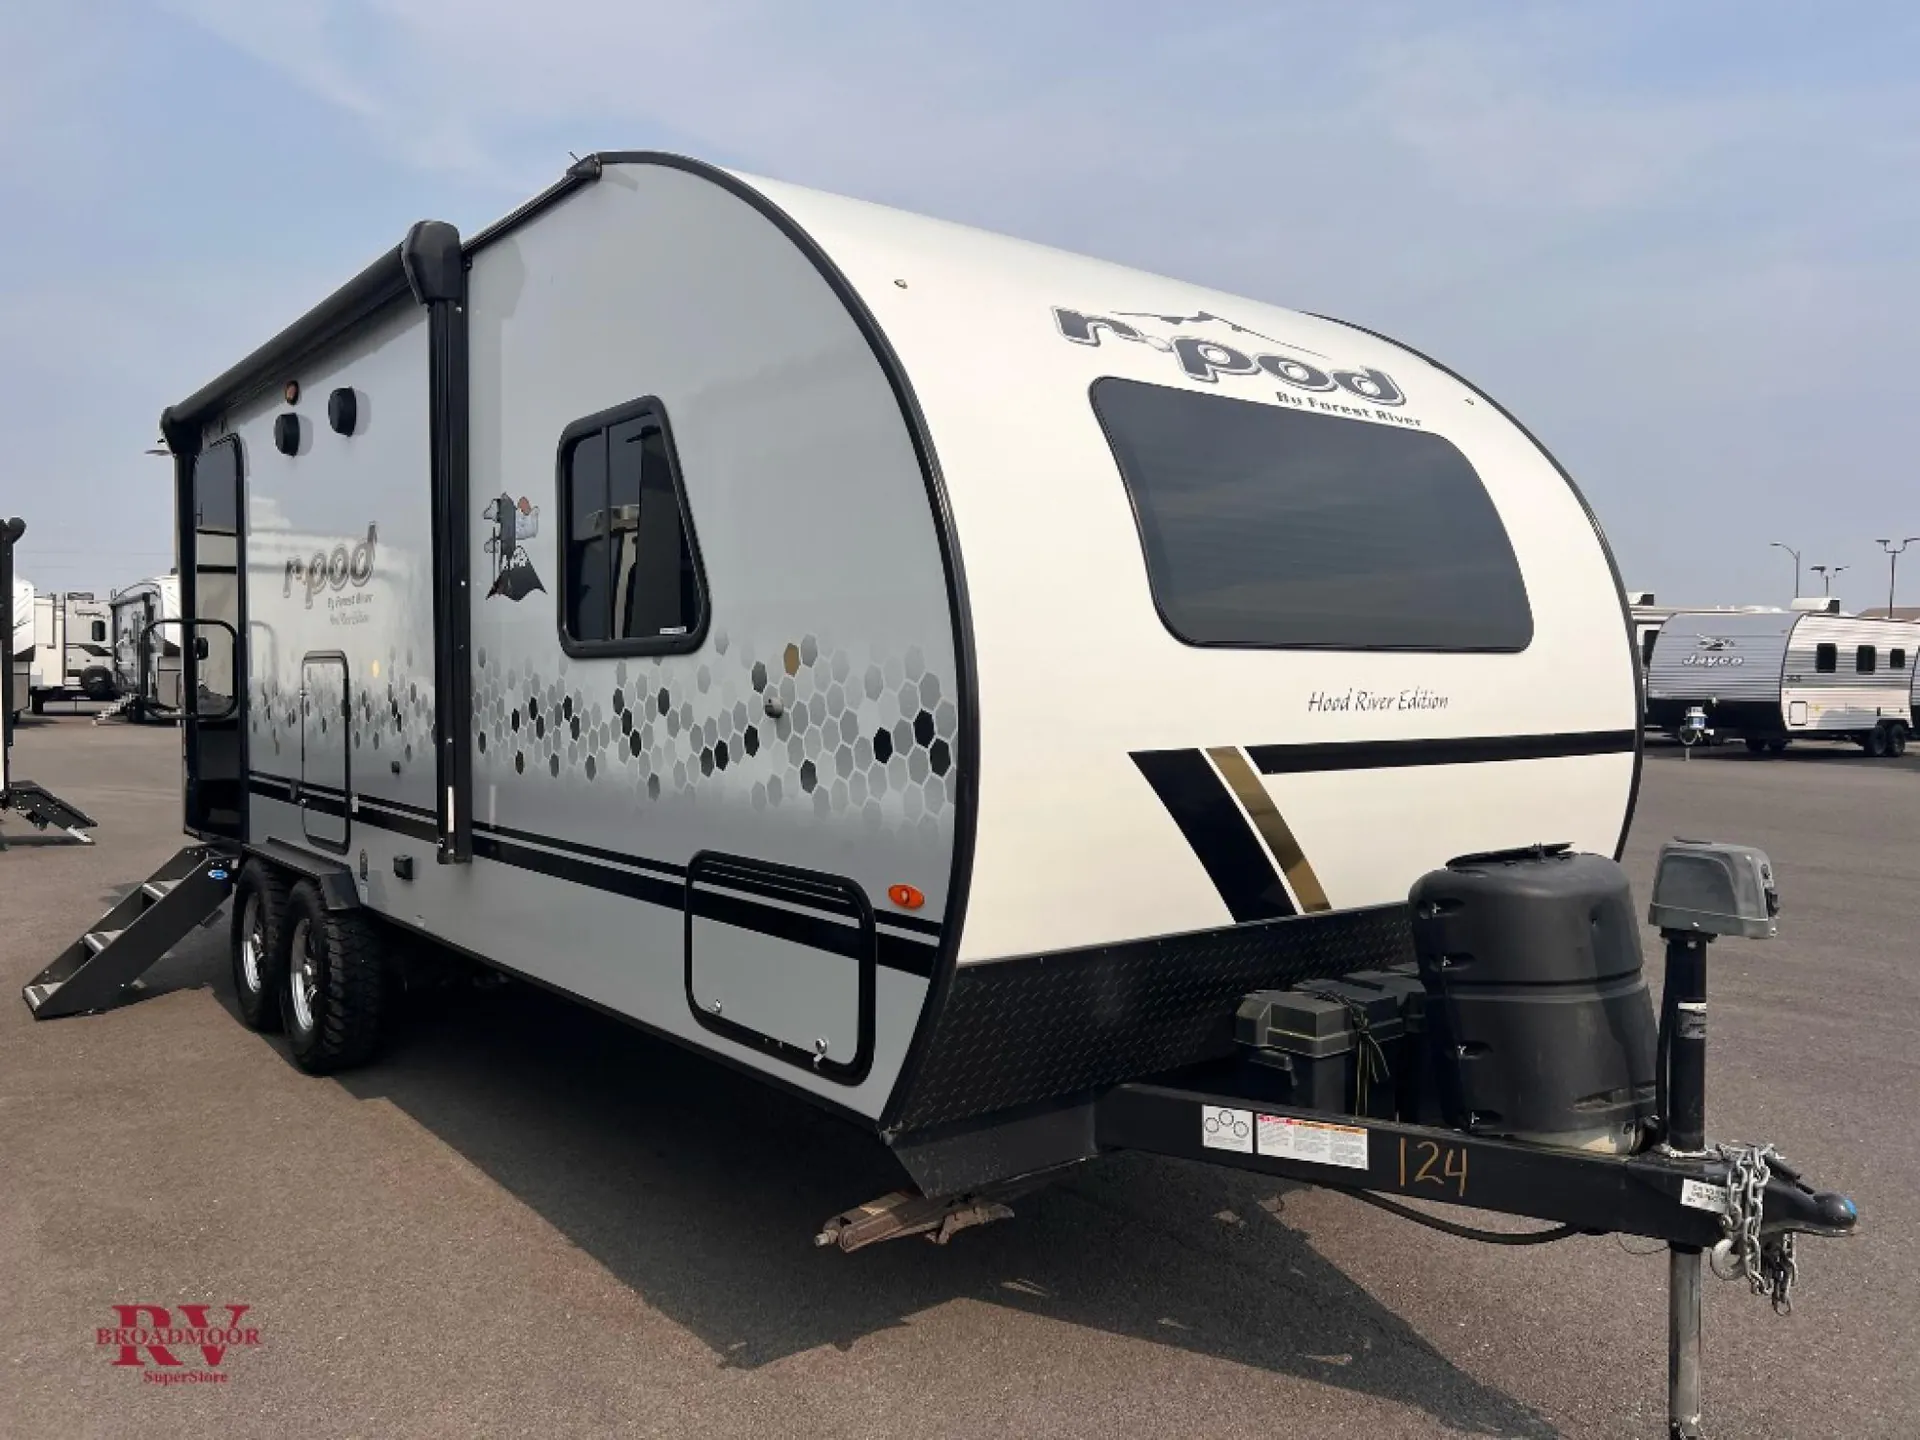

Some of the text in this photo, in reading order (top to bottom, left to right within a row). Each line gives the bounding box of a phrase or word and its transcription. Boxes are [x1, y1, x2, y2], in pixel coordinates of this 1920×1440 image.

[1307, 397, 1373, 419] Forest
[1376, 409, 1422, 427] River
[1682, 653, 1744, 668] Jayco
[1308, 685, 1449, 711] Hood River Edition
[1399, 1136, 1468, 1197] 124
